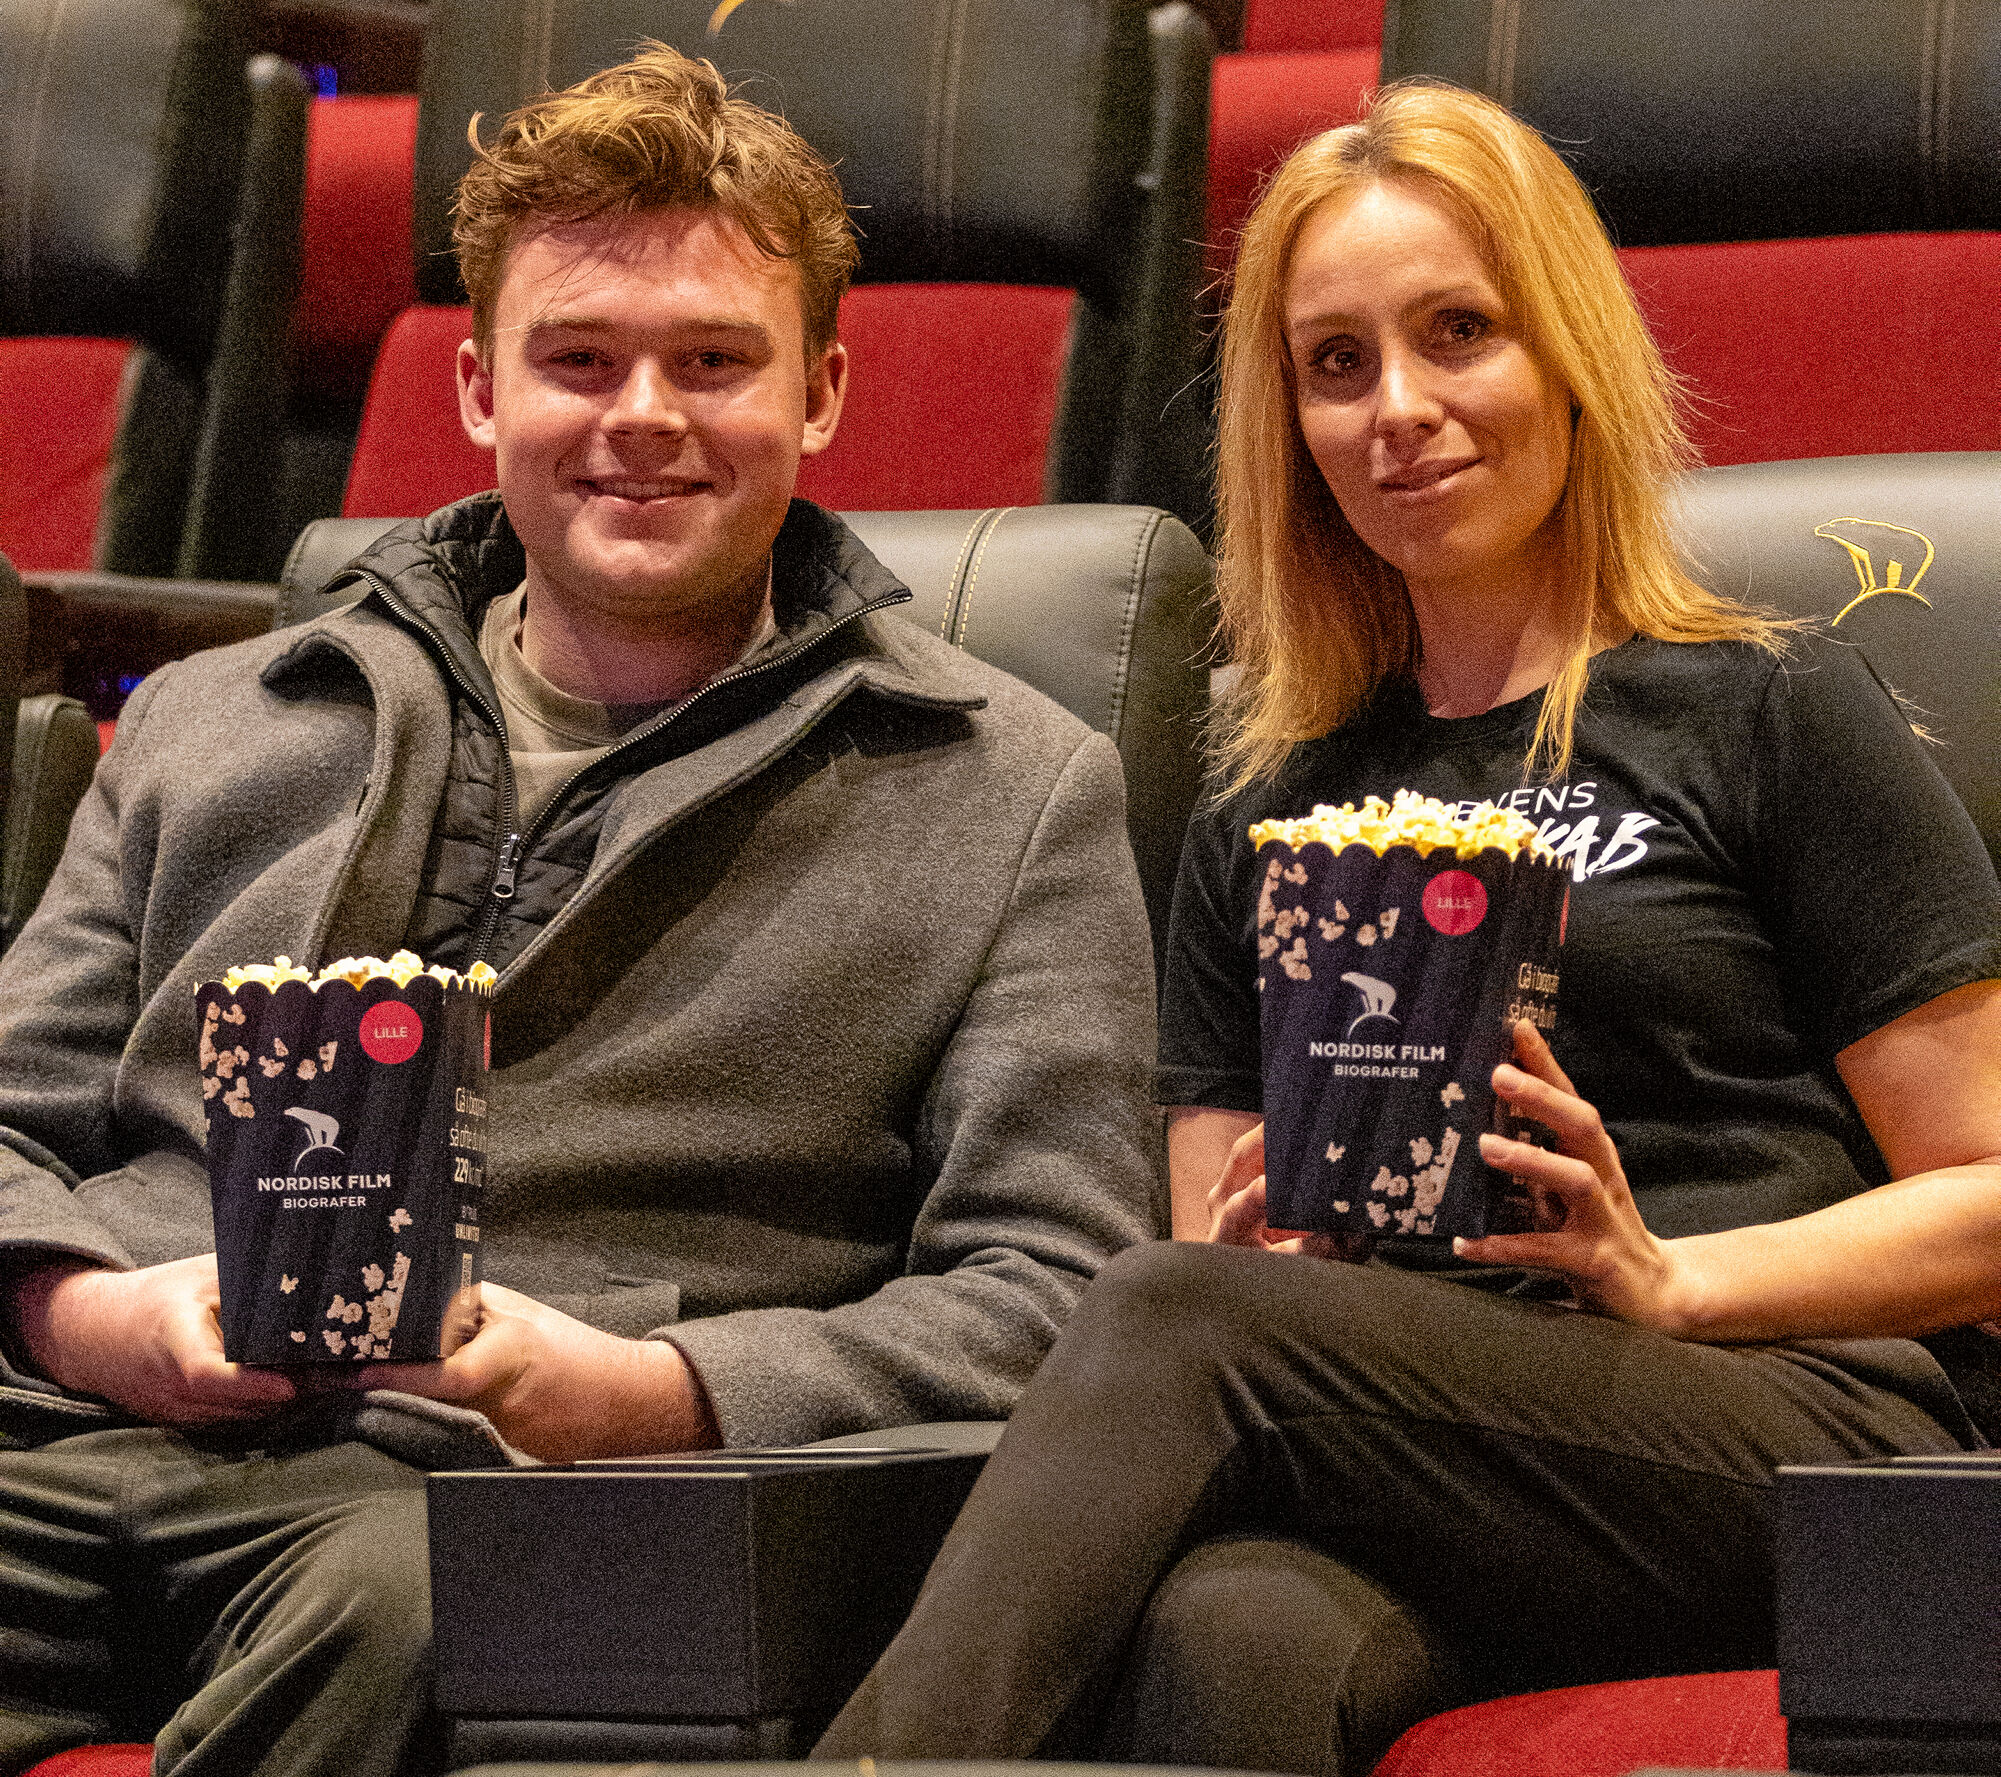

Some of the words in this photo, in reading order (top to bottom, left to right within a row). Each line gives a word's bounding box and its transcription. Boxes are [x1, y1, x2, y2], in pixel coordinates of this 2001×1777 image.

[1437, 896, 1471, 909] LILLE
[374, 1026, 408, 1038] LILLE
[1309, 1041, 1396, 1060] NORDISK
[1401, 1045, 1446, 1061] FILM
[1333, 1064, 1419, 1079] BIOGRAFER
[258, 1175, 343, 1191] NORDISK
[347, 1173, 391, 1189] FILM
[283, 1196, 367, 1209] BIOGRAFER
